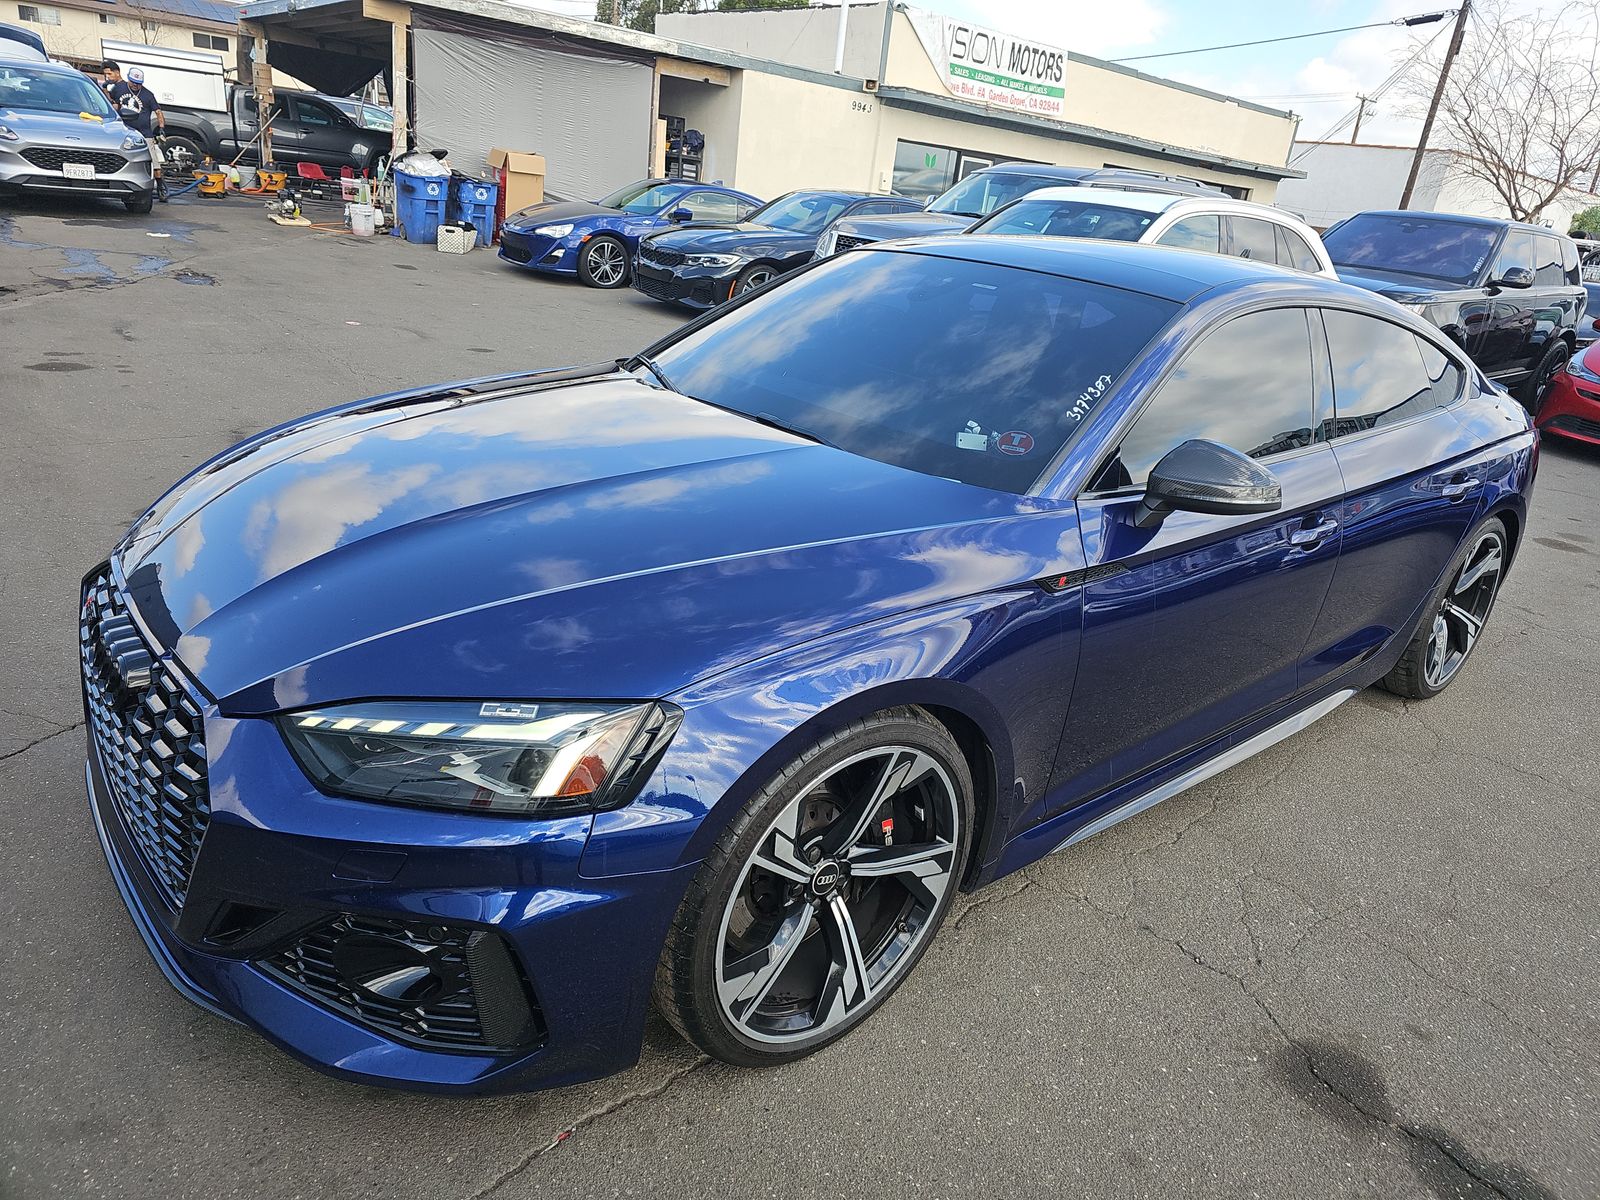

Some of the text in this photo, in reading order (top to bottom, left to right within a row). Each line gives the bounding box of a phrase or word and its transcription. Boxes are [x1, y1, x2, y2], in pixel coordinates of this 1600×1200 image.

[948, 23, 1063, 82] ISION MOTORS
[954, 66, 970, 77] SALES
[975, 72, 996, 84] LEASING
[1000, 79, 1009, 87] ALL
[989, 89, 1009, 103] Garden
[1029, 98, 1038, 109] CA
[1039, 99, 1060, 112] 92844
[1066, 374, 1112, 421] 3974387
